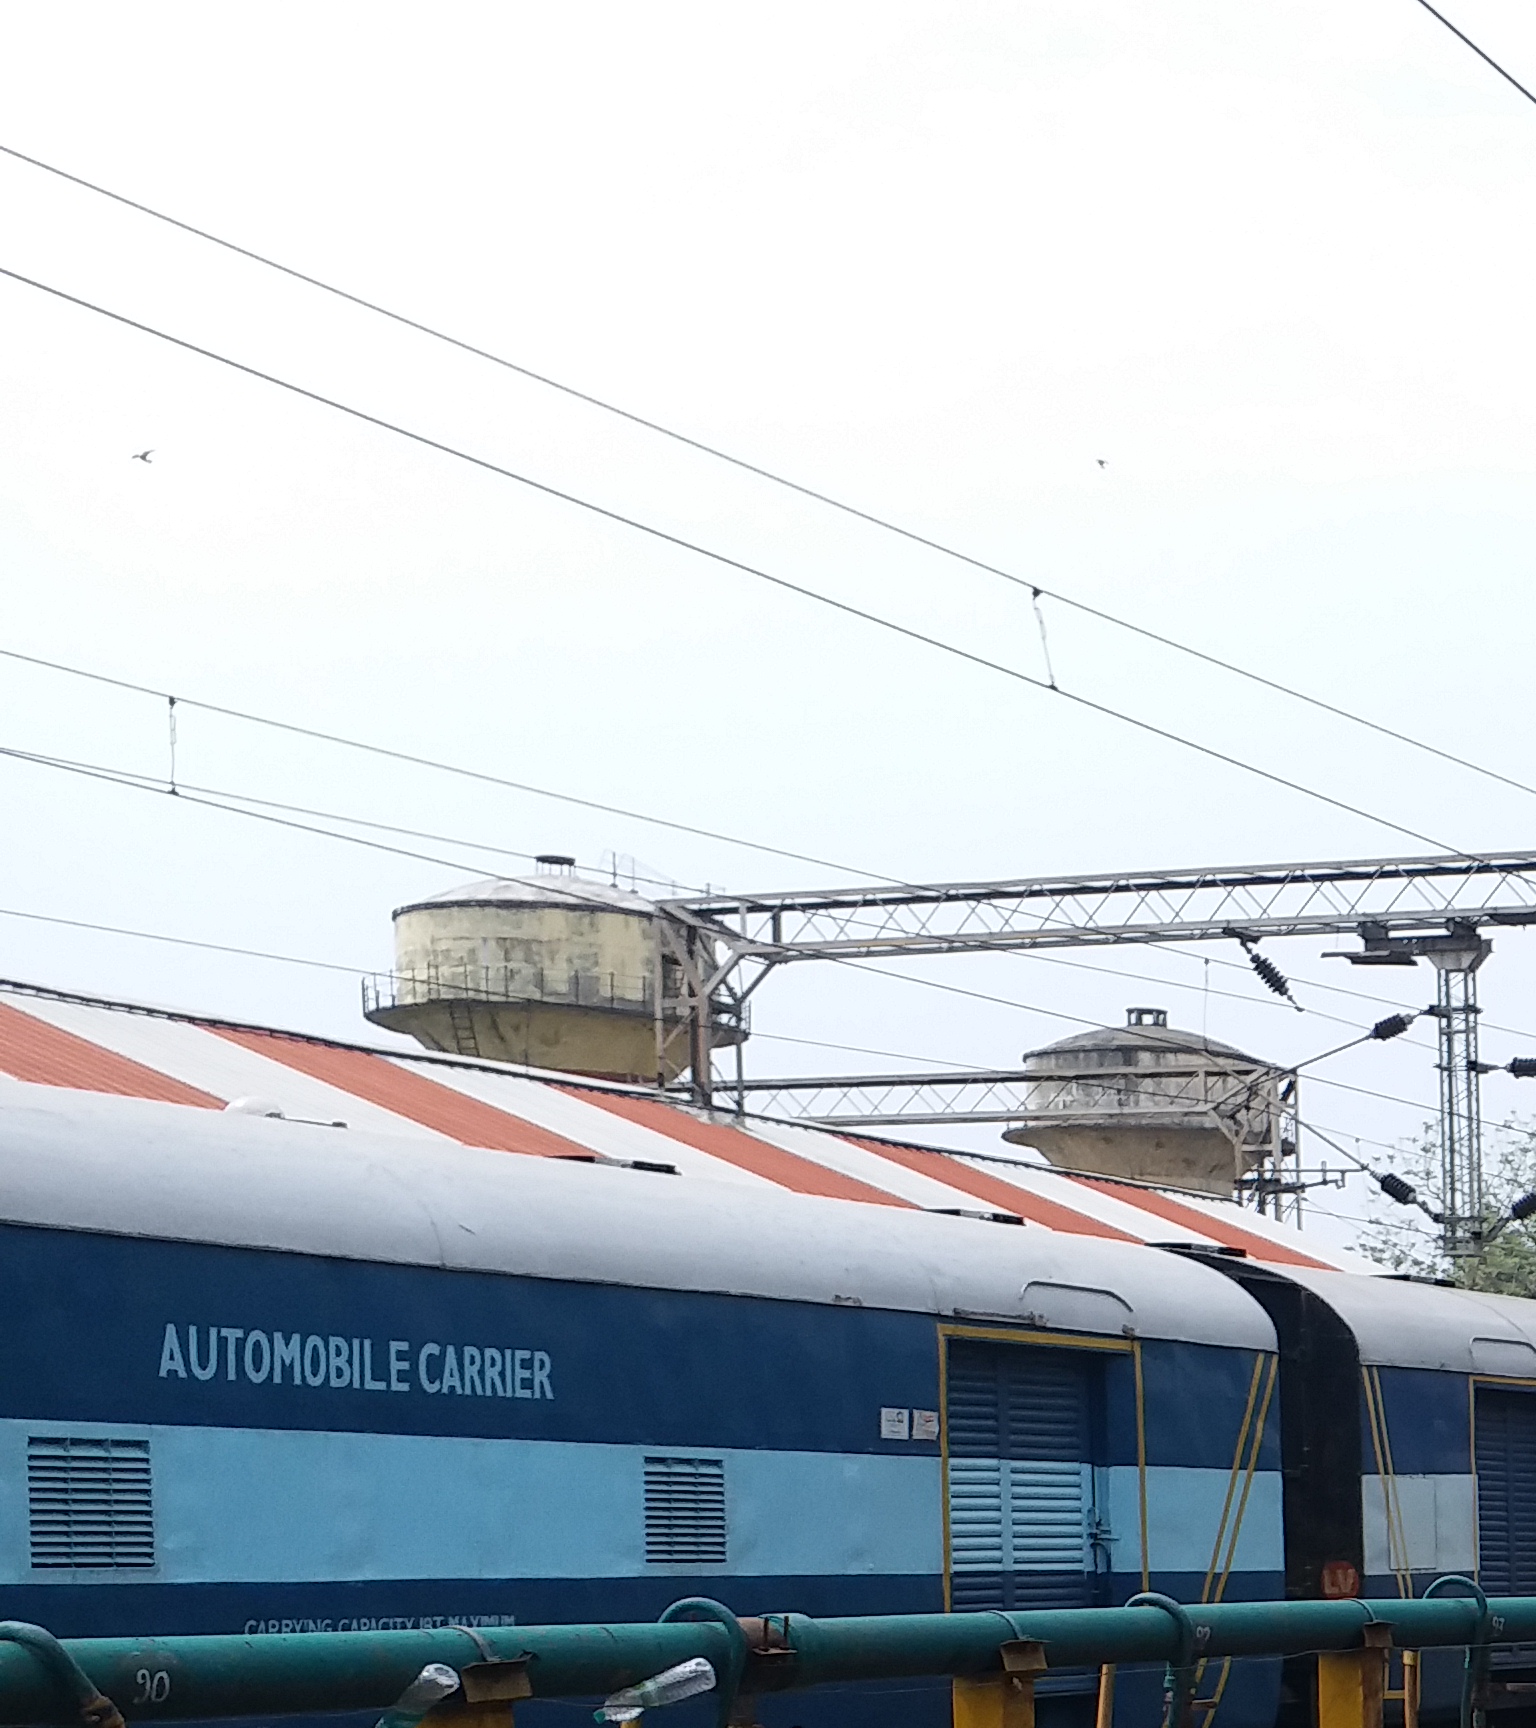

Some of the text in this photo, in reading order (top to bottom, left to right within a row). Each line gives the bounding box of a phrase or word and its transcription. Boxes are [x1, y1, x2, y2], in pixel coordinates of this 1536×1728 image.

[158, 1323, 554, 1400] AUTOMOBILE CARRIER
[1323, 1569, 1355, 1594] LV
[134, 1669, 170, 1703] 90
